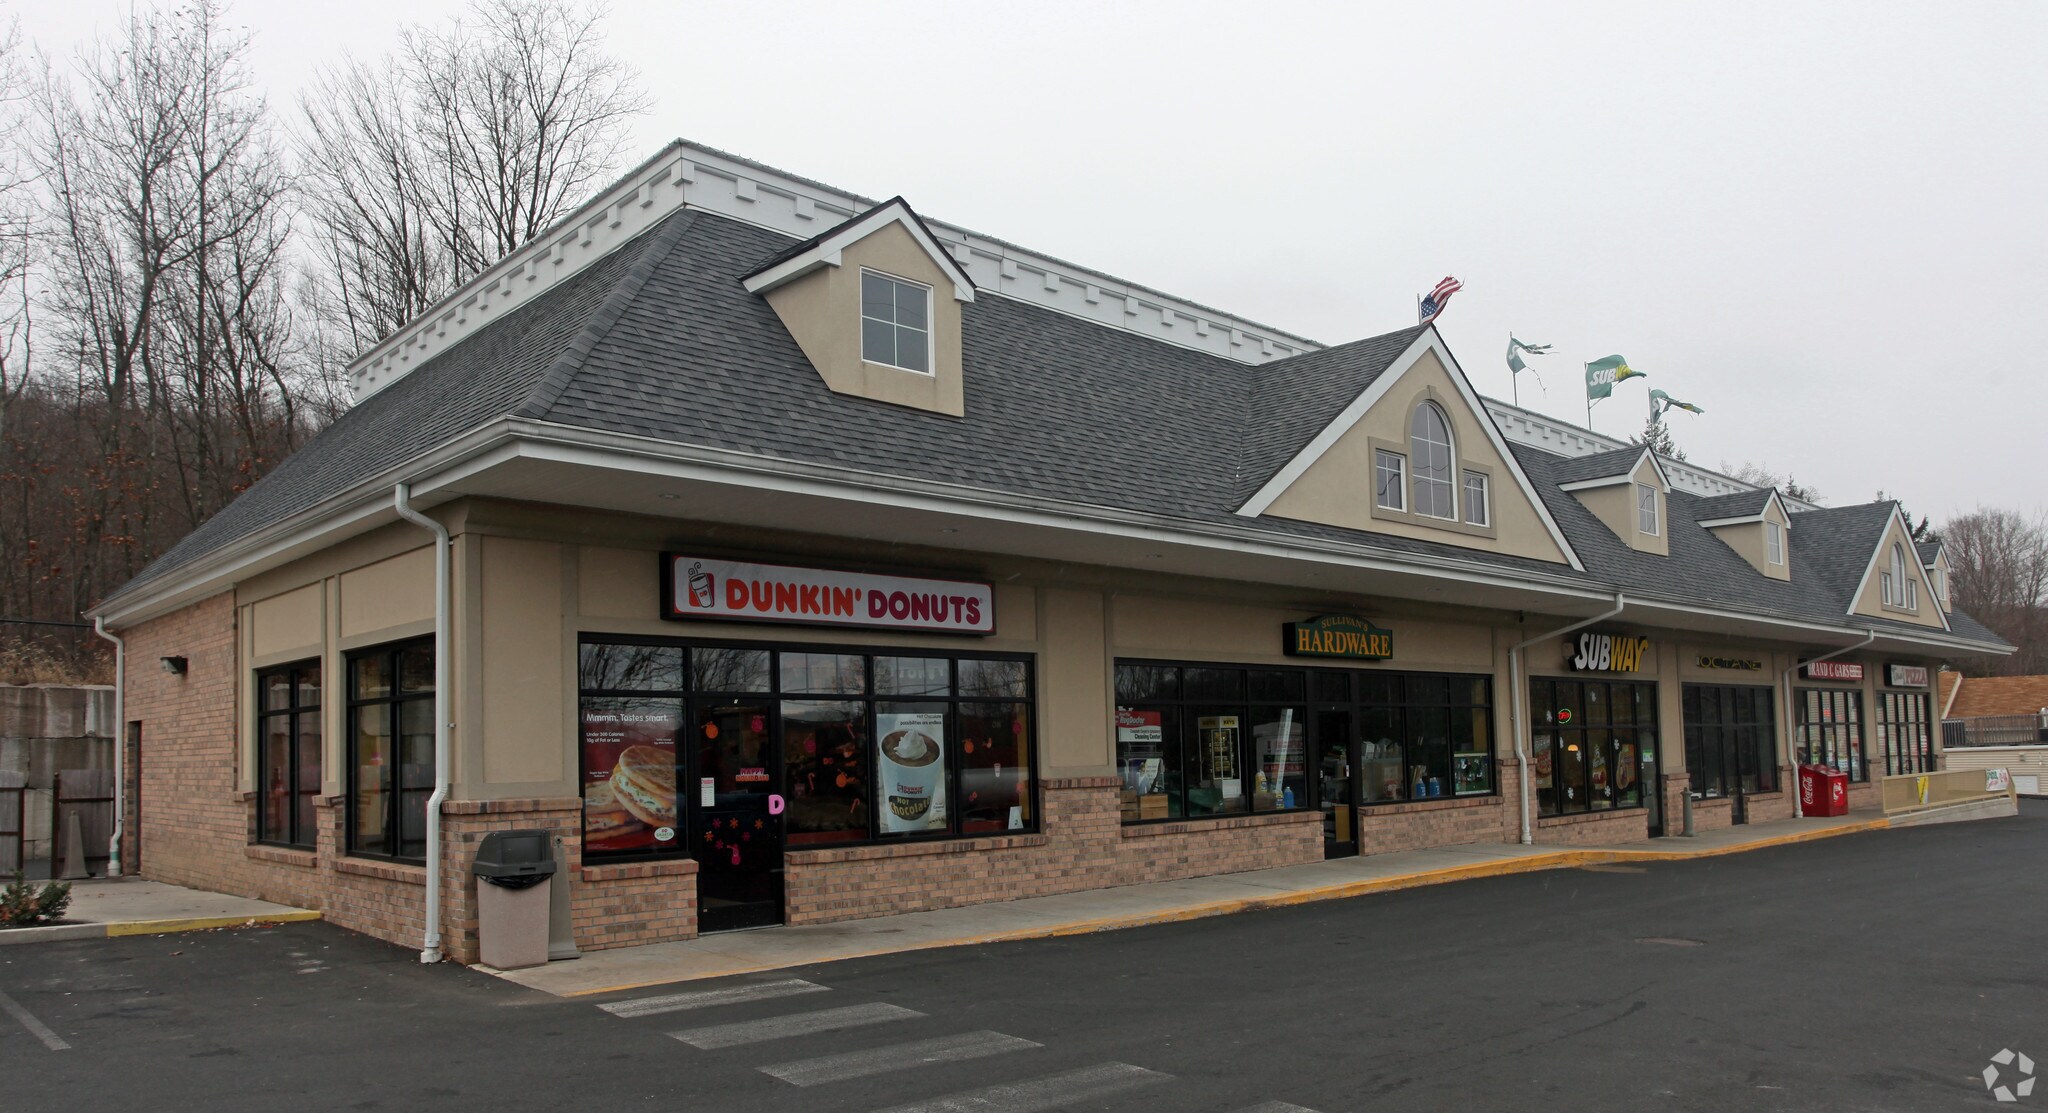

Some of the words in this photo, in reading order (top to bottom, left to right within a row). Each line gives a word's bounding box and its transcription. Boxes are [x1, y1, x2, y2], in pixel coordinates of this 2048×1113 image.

[725, 578, 862, 617] DUNKIN'
[868, 589, 982, 625] DONUTS
[1321, 616, 1369, 632] SULLIVAN'S
[1298, 628, 1391, 656] HARDWARE
[1574, 632, 1649, 673] SUBWAY
[1904, 668, 1928, 685] PIZZA
[586, 713, 619, 722] Mmmm.
[620, 713, 644, 722] Tastes
[645, 714, 669, 722] smart.
[897, 797, 909, 805] HOT
